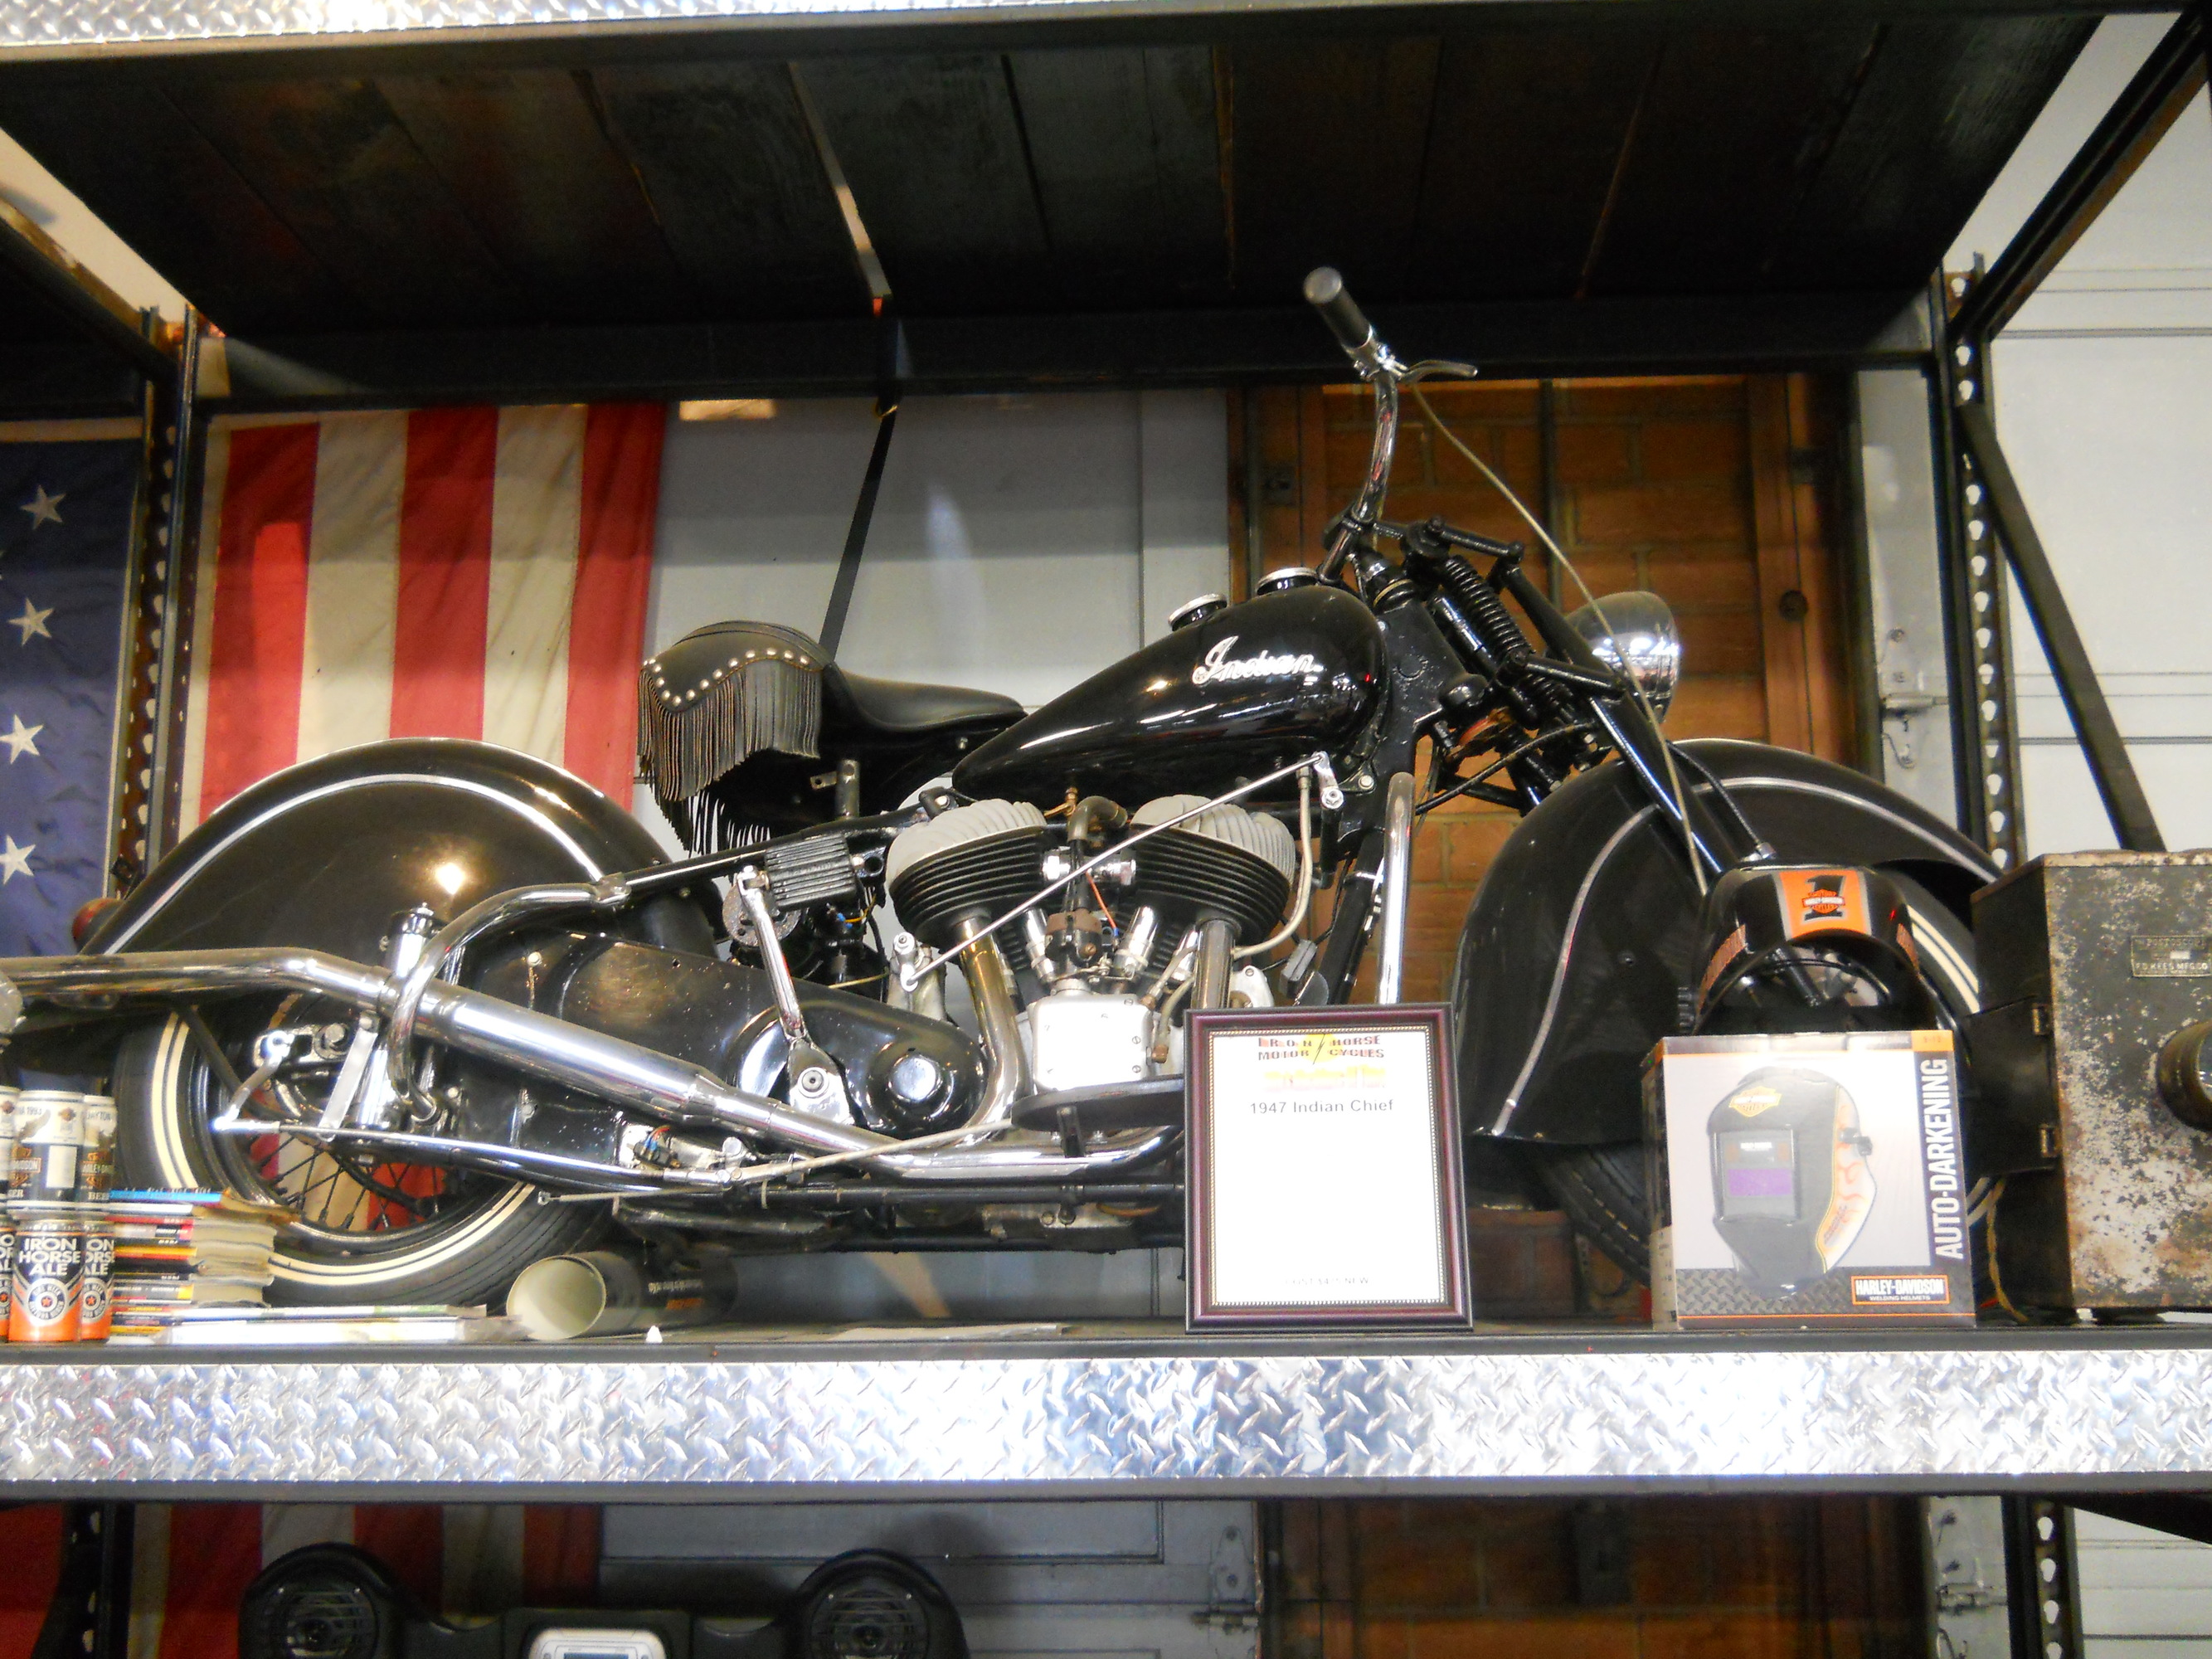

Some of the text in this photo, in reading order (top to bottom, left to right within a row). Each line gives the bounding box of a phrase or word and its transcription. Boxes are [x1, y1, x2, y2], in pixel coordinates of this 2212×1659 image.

[1191, 635, 1325, 686] Indian
[1257, 1034, 1381, 1048] IRON HORSE
[1257, 1048, 1385, 1061] MOTOR CYCLES
[1250, 1098, 1394, 1115] 1947 Indian Chief
[24, 1238, 78, 1252] IRON
[85, 1238, 115, 1252] ON
[19, 1250, 81, 1263] HORSE
[28, 1262, 68, 1276] ALE
[1855, 1279, 1944, 1295] HARLEY-DAVIDSON
